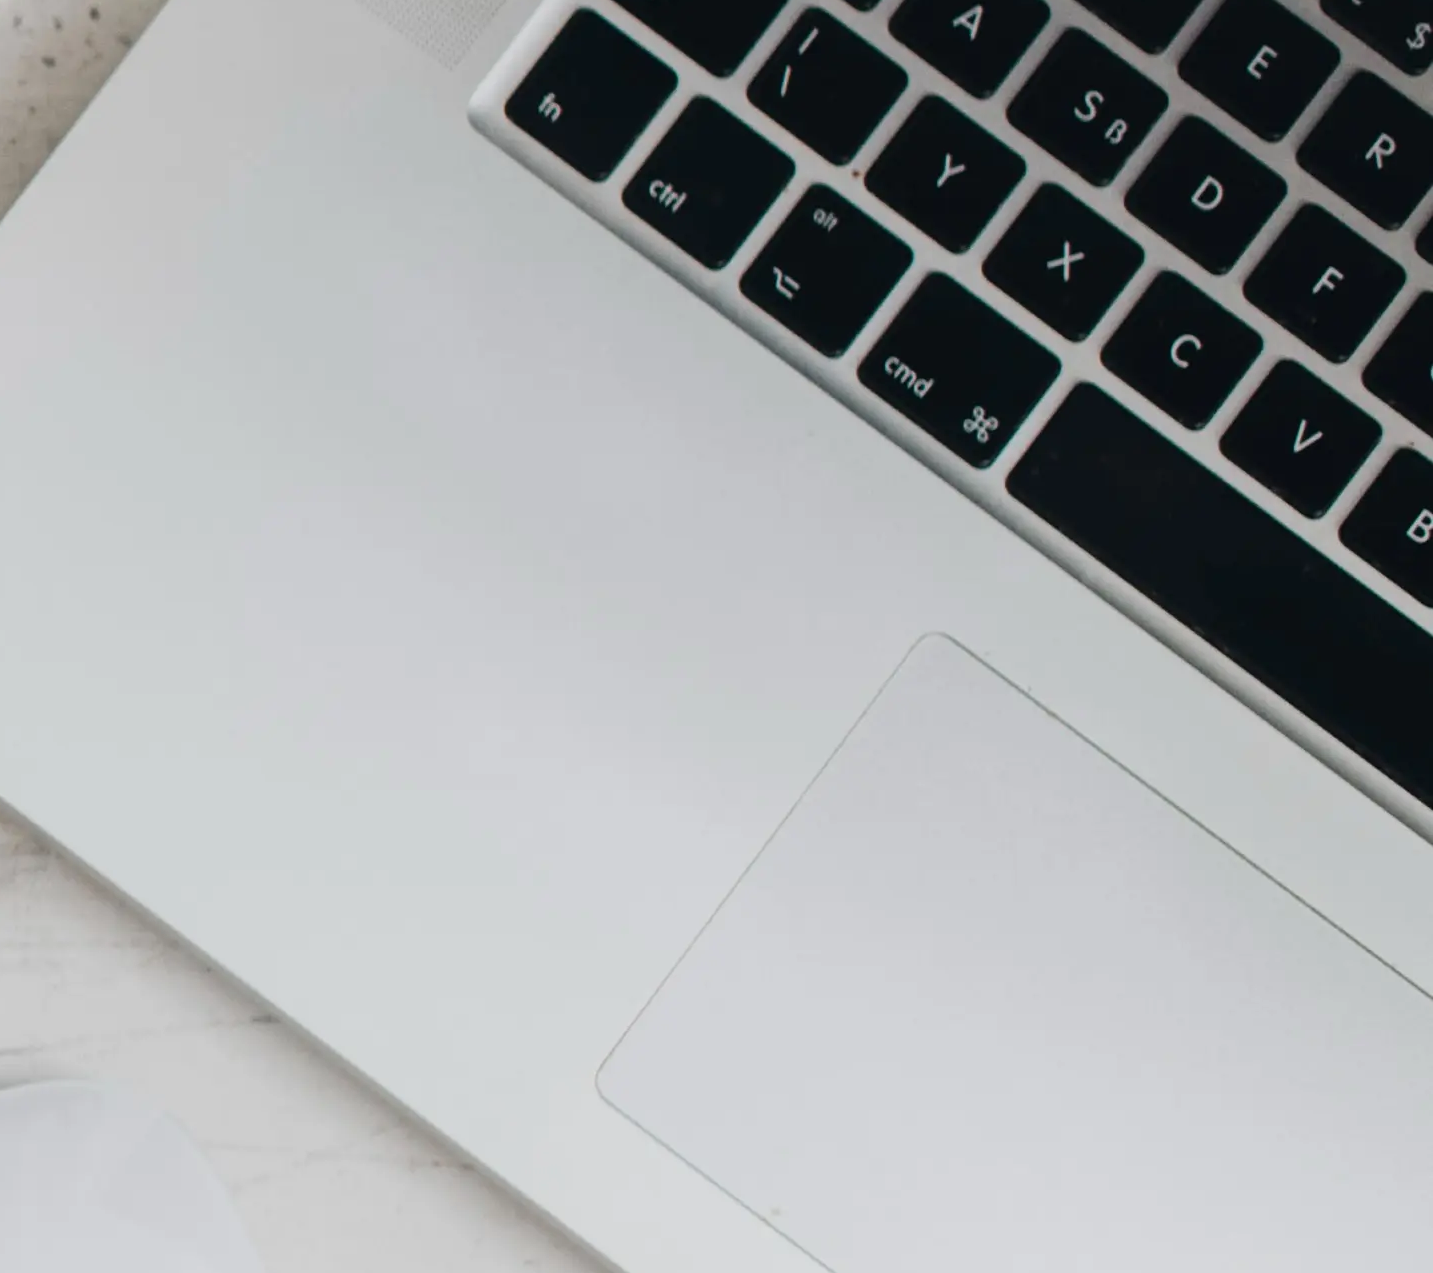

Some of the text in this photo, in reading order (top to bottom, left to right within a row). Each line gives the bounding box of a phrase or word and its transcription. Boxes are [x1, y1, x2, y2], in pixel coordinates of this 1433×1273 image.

[952, 5, 984, 40] A
[1406, 22, 1432, 51] $
[1247, 45, 1278, 79] E
[538, 92, 562, 122] fn
[1074, 90, 1105, 122] S
[1365, 132, 1396, 169] R
[936, 153, 966, 188] Y
[648, 179, 687, 214] ctrl
[1191, 175, 1224, 211] D
[813, 208, 839, 232] alt
[1046, 241, 1084, 281] X
[1312, 266, 1344, 296] F
[1170, 334, 1201, 368] C
[883, 355, 935, 399] cmd
[1293, 419, 1323, 453] V
[1406, 508, 1433, 544] B
